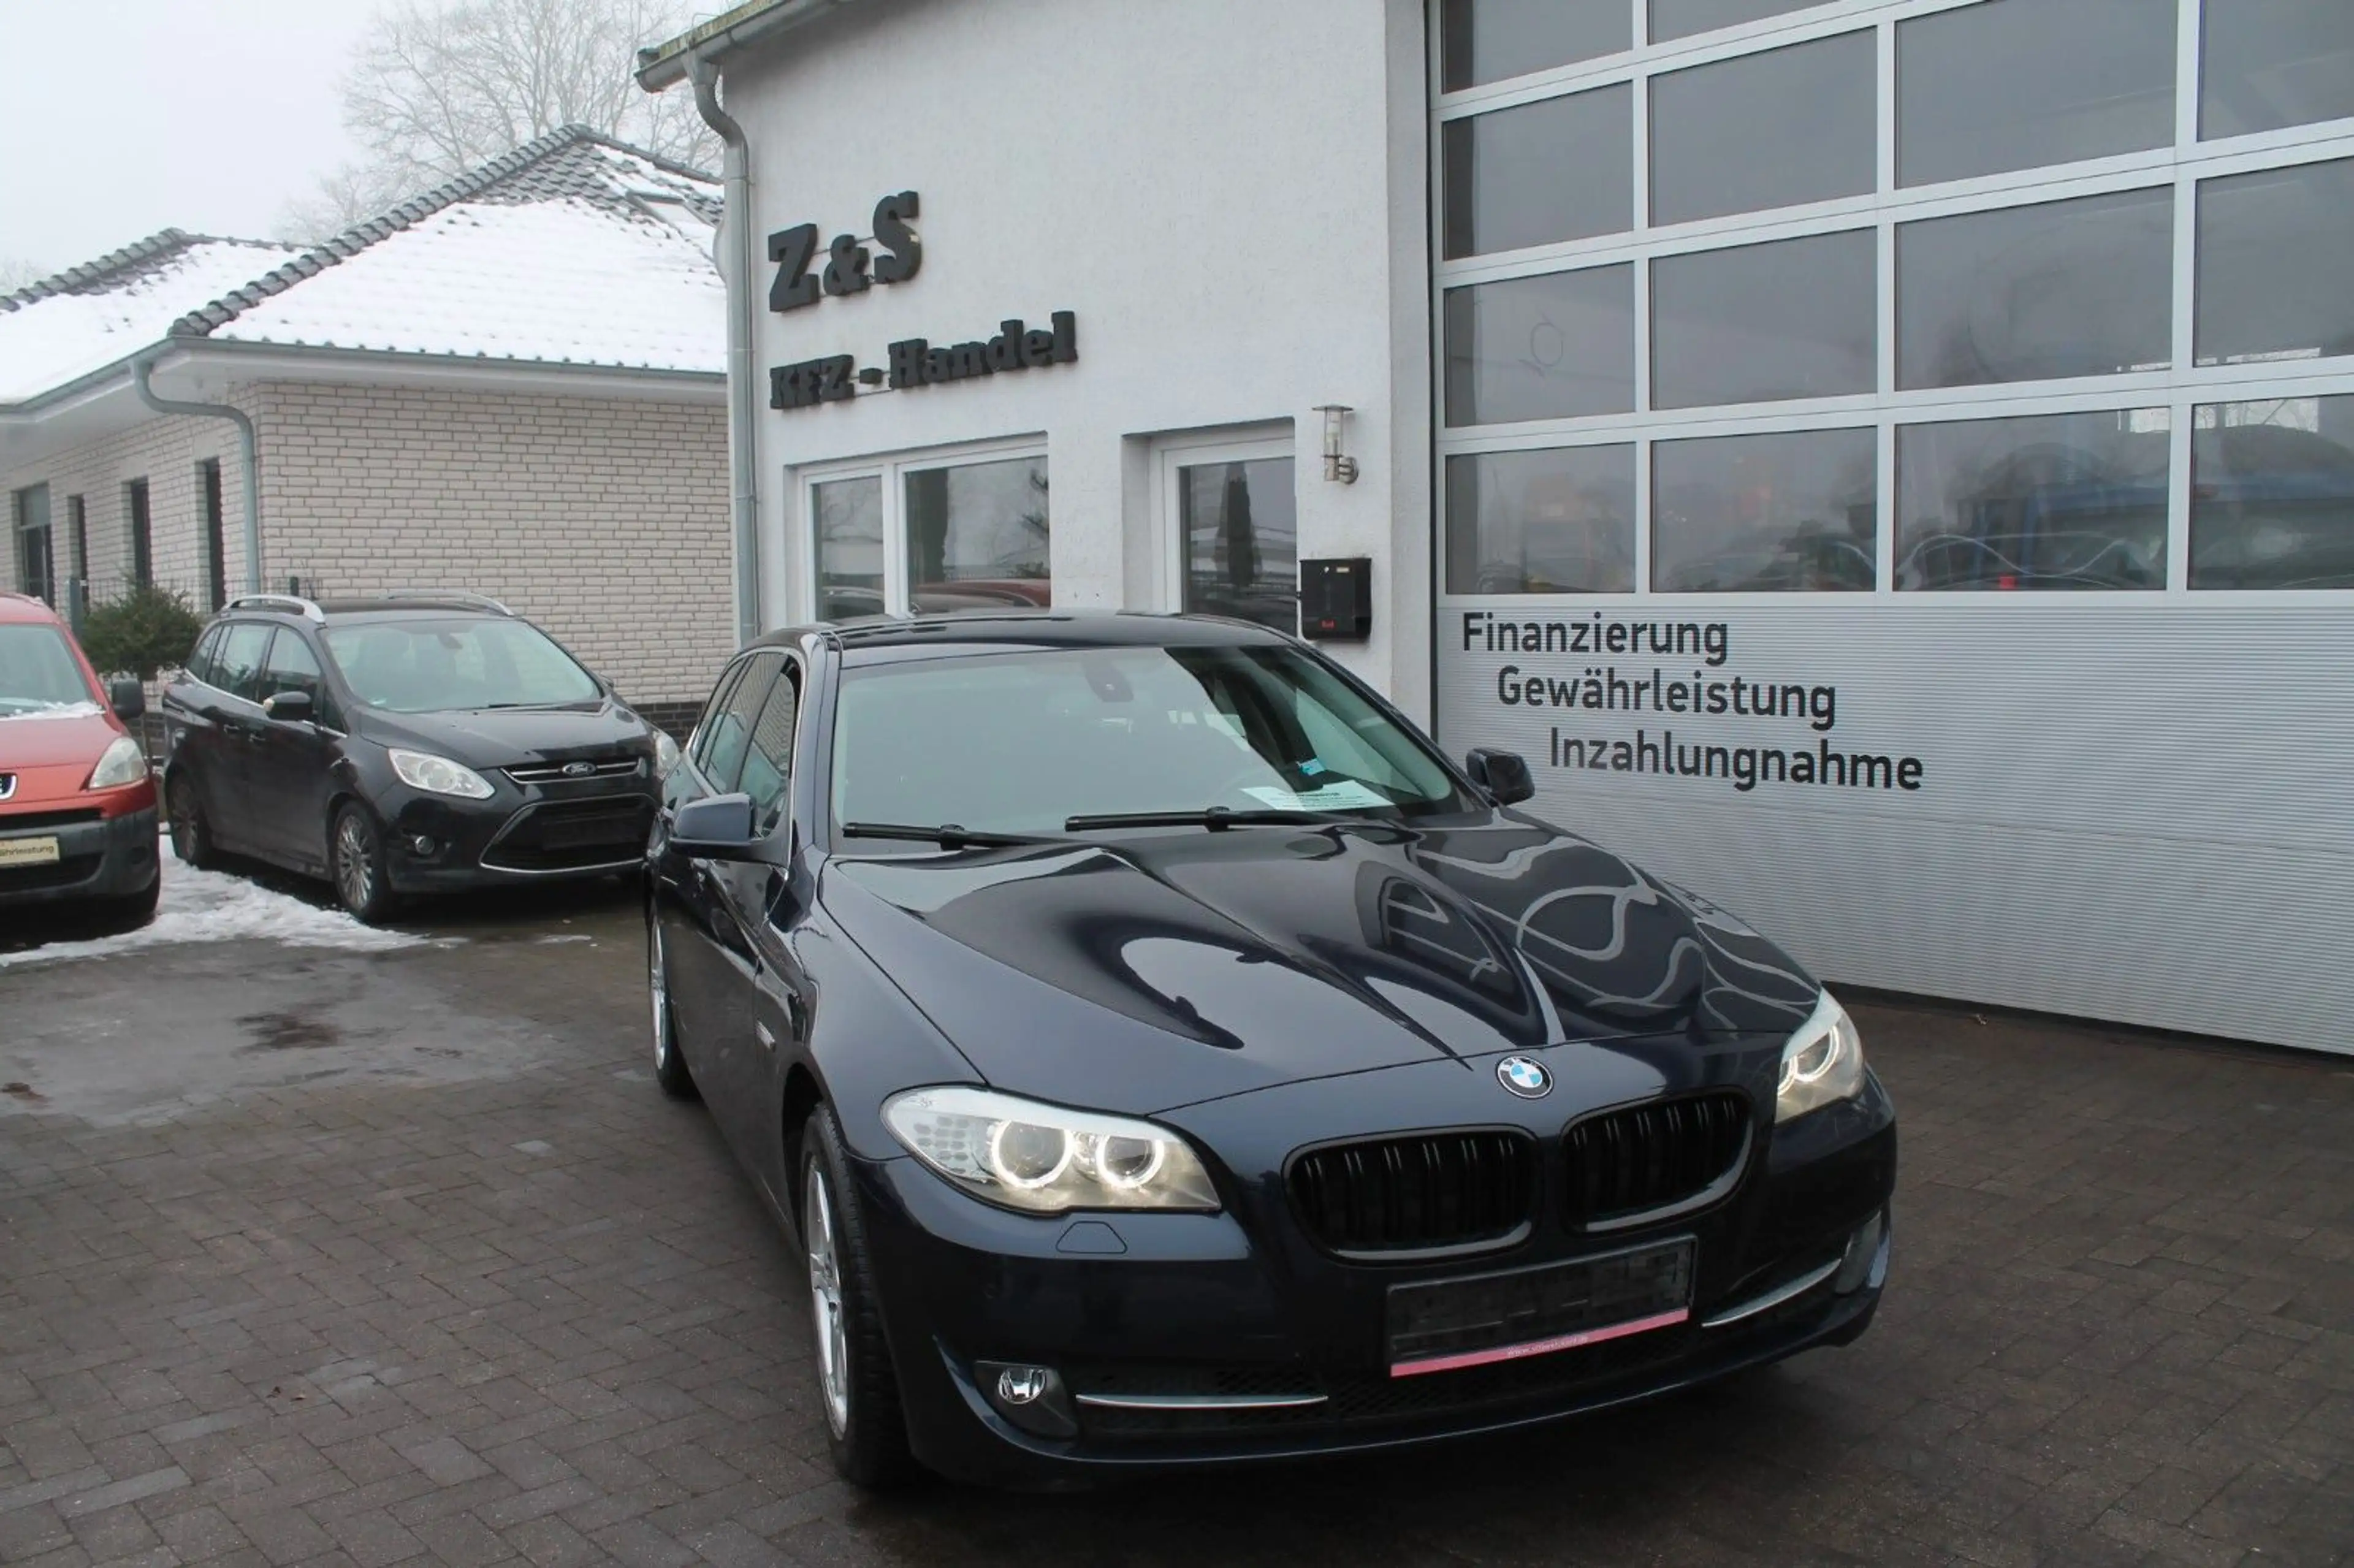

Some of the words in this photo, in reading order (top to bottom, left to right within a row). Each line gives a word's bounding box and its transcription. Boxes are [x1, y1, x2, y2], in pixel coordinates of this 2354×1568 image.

[768, 190, 922, 312] Z&S
[1463, 611, 1727, 667] Finanzierung
[1498, 665, 1836, 731] Gewährleistung
[1550, 728, 1924, 791] Inzahlungnahme
